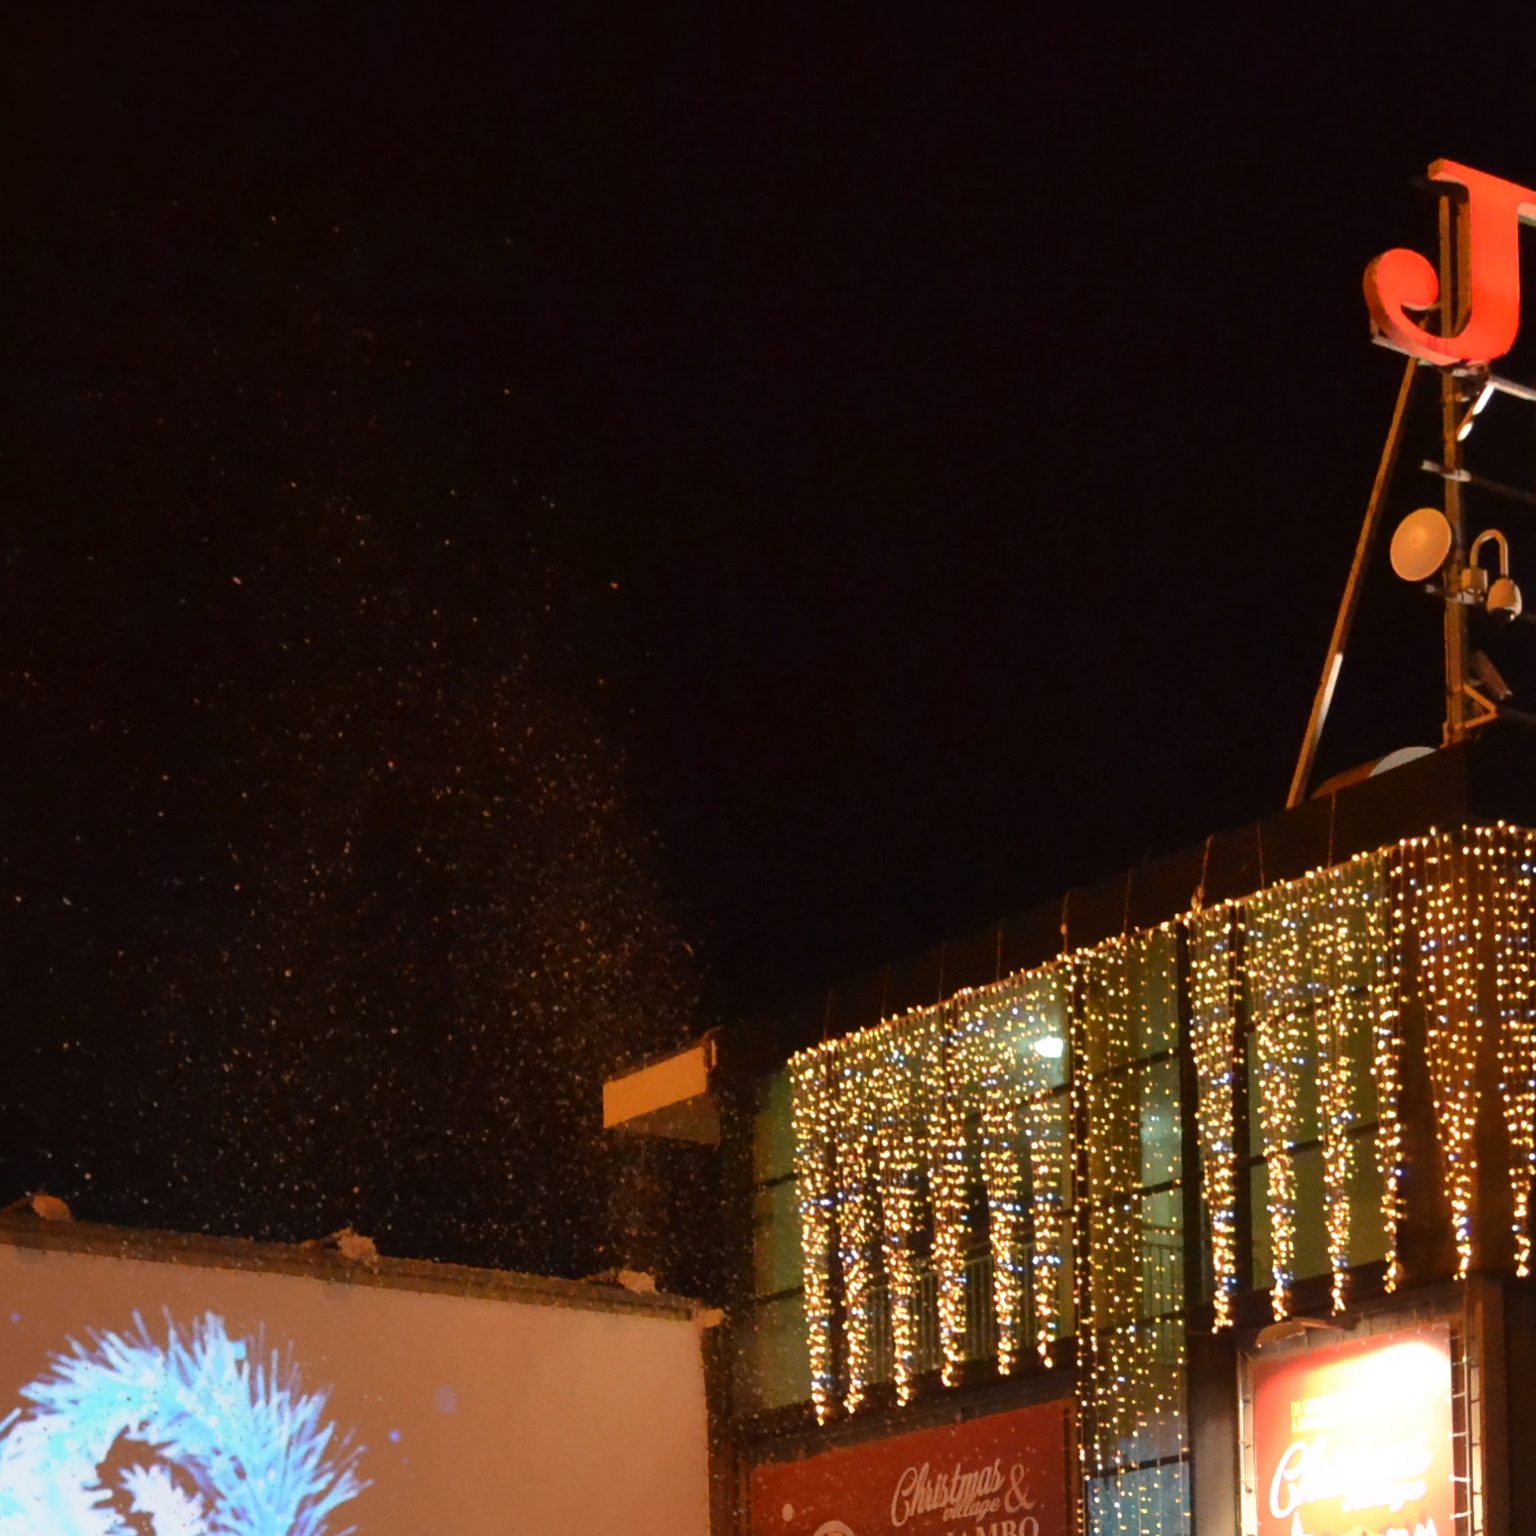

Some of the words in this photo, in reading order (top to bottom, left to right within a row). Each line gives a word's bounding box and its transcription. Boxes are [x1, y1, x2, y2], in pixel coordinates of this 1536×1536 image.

[891, 1458, 1005, 1527] Christmas
[1004, 1463, 1034, 1513] &
[943, 1498, 1000, 1522] village
